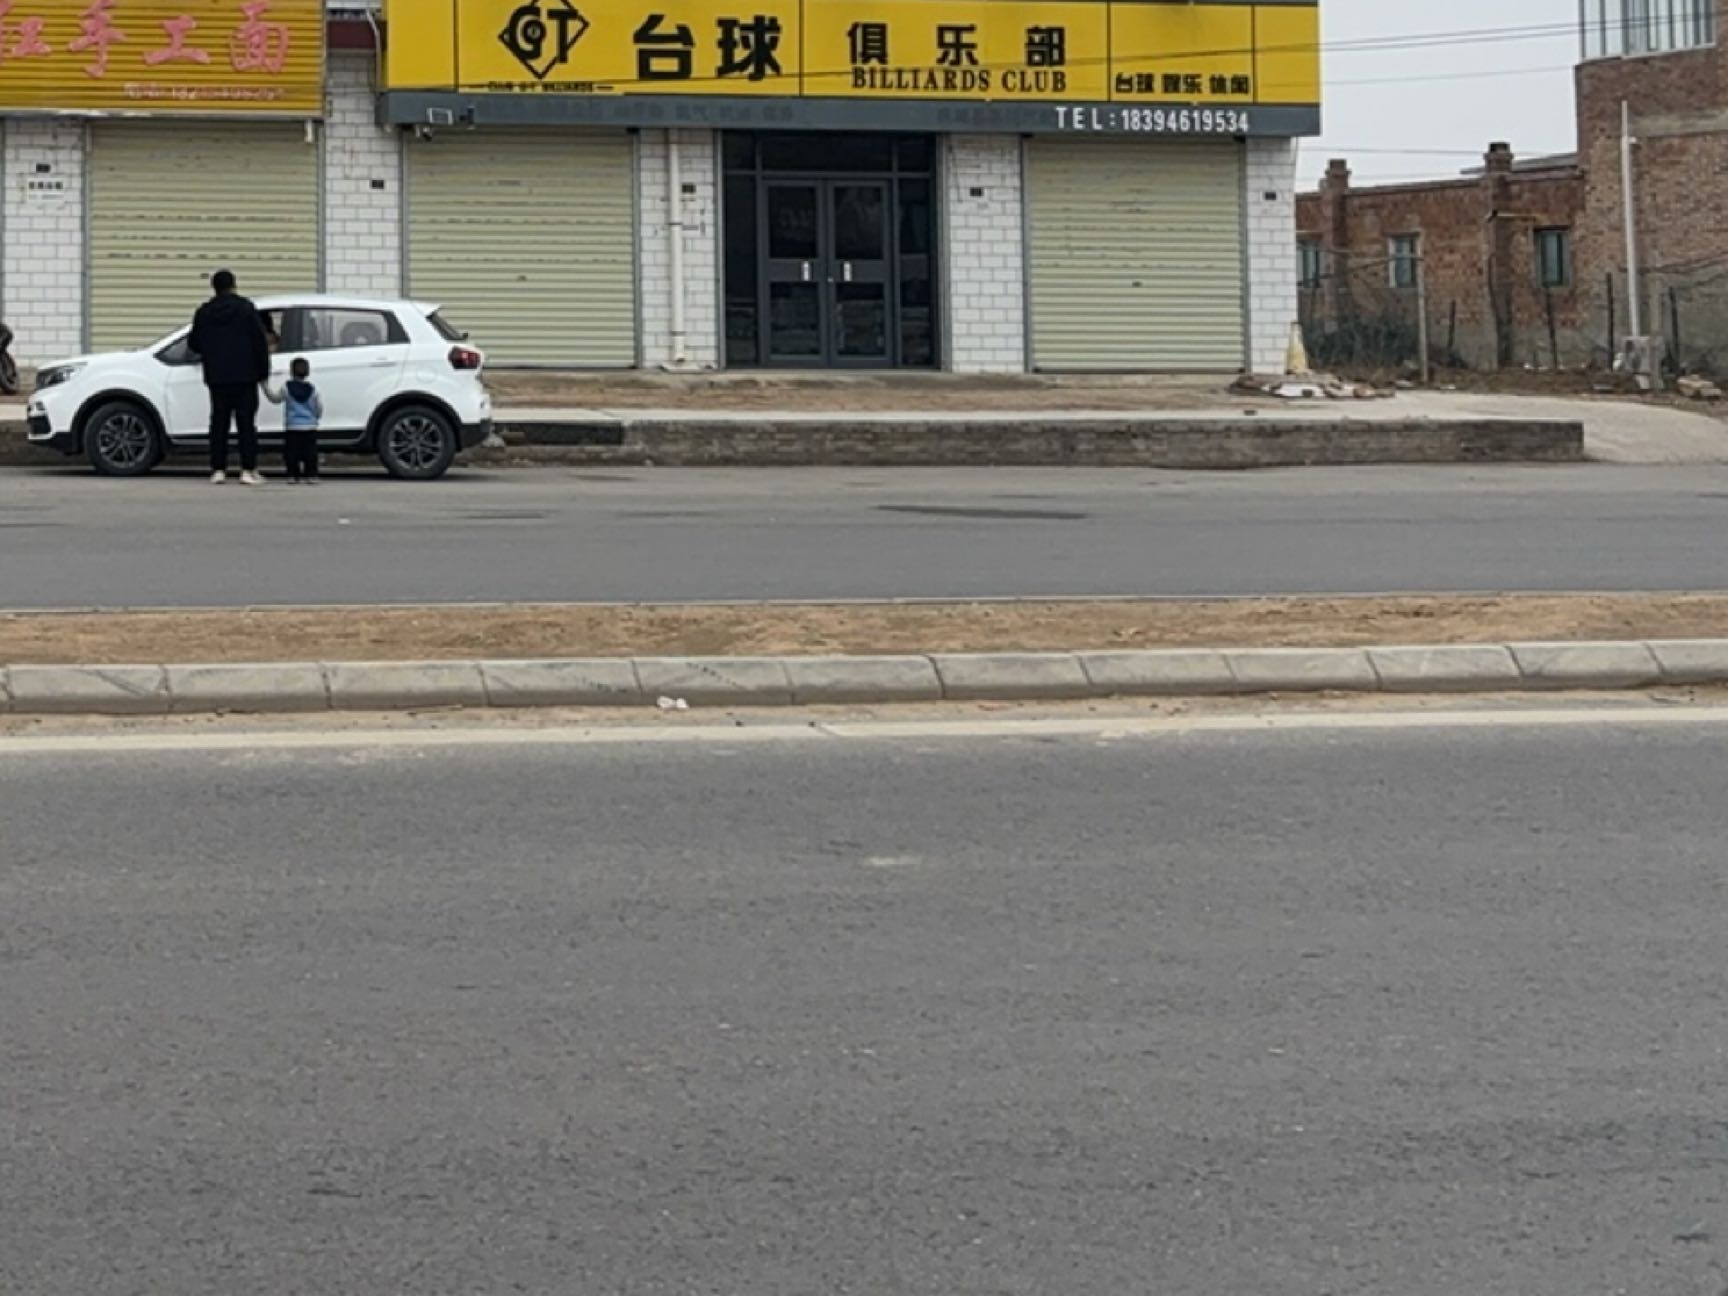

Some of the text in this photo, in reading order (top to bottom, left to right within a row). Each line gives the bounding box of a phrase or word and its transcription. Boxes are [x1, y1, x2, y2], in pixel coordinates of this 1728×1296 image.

[633, 14, 1067, 81] 台球 俱乐部
[851, 66, 1068, 93] BILLIARDS CLUB
[1115, 72, 1154, 93] 台球
